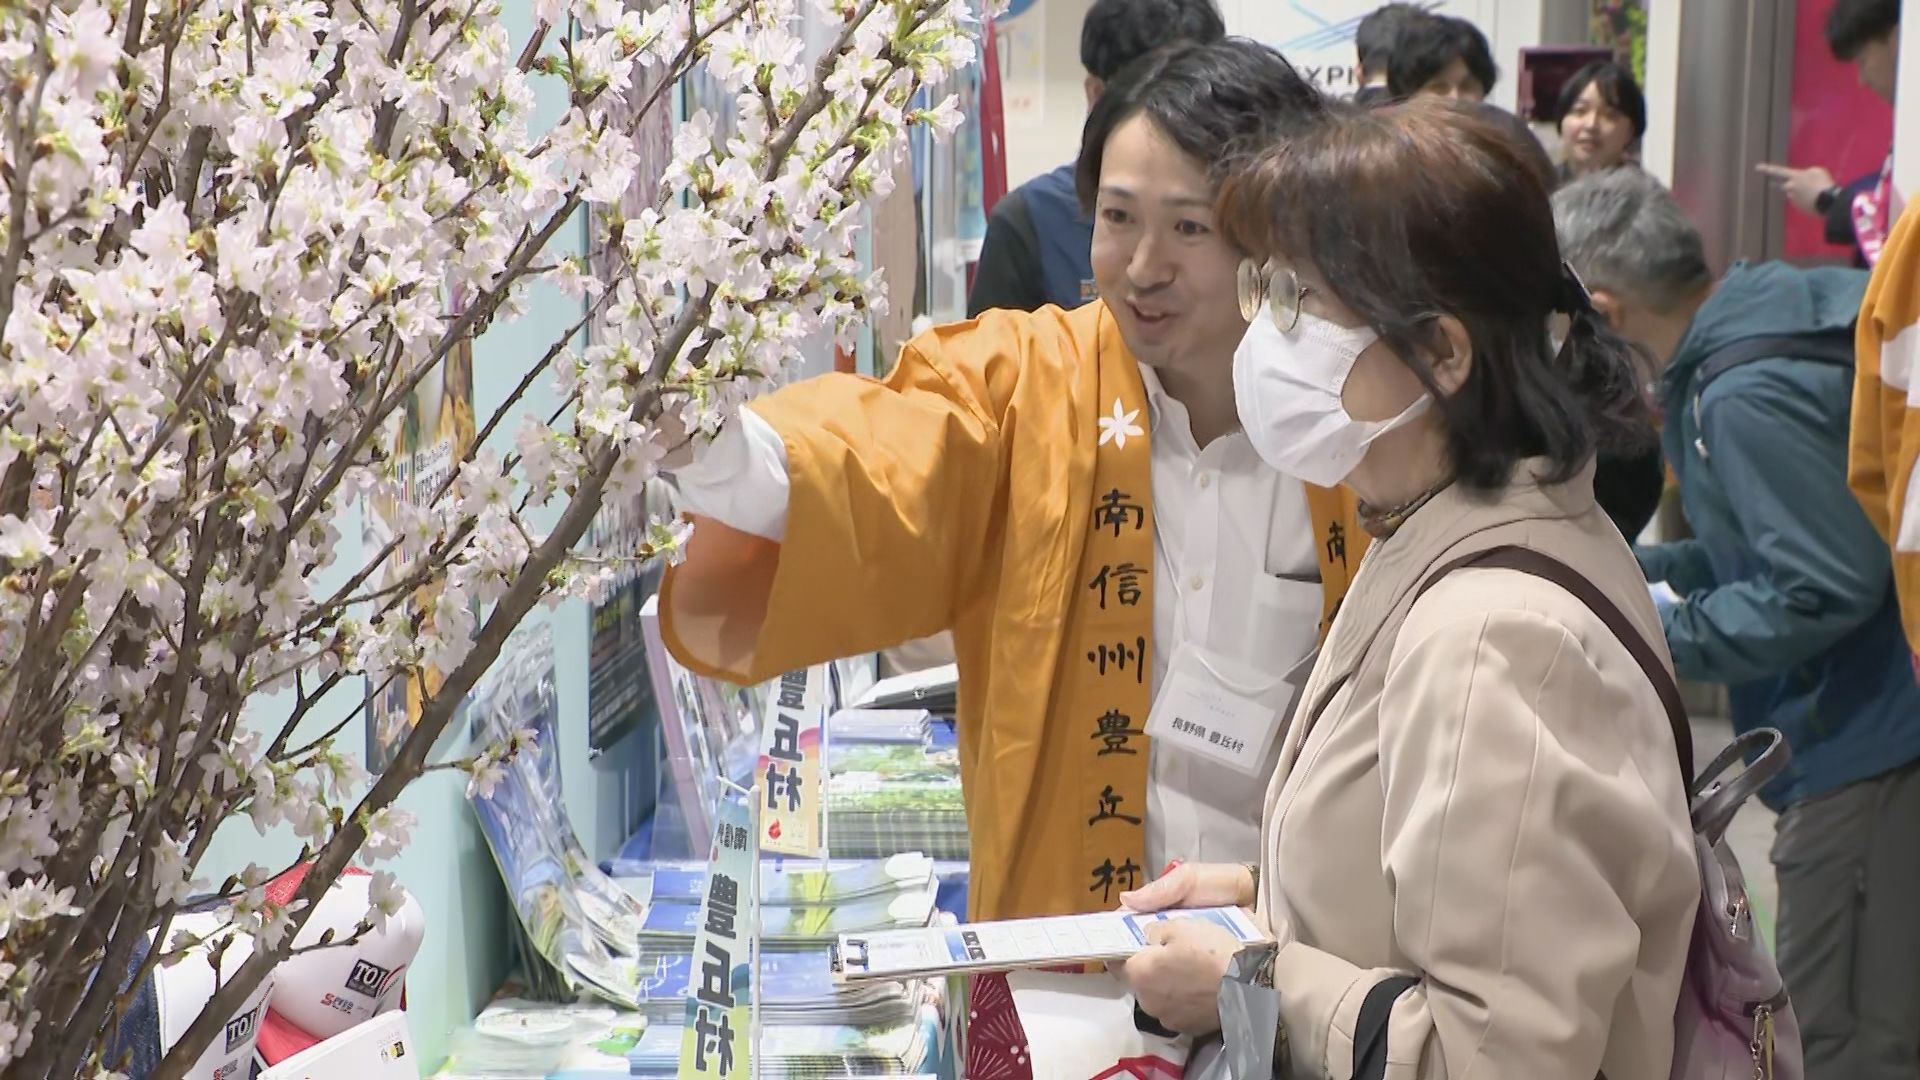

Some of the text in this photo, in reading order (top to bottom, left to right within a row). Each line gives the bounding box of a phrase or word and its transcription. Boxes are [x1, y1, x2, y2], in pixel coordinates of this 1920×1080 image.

[1086, 487, 1149, 903] 南信州豊丘村
[1171, 717, 1245, 754] 長野県 豊丘村
[354, 962, 387, 988] TOJ
[229, 1012, 256, 1041] TOJ
